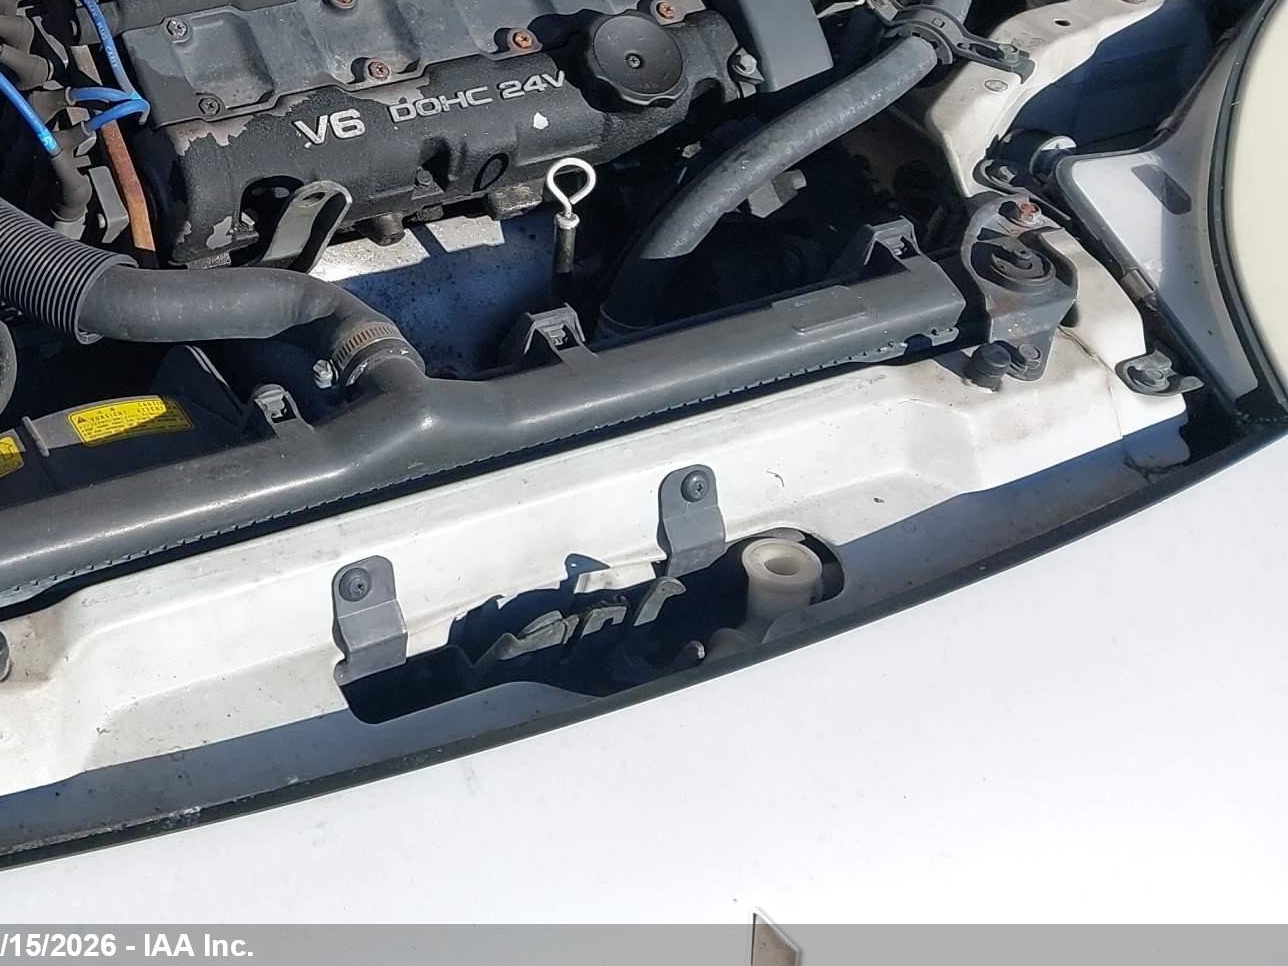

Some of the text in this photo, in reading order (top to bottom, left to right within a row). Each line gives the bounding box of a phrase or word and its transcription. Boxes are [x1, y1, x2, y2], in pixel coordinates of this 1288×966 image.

[294, 70, 565, 145] V6 DOHC 24V
